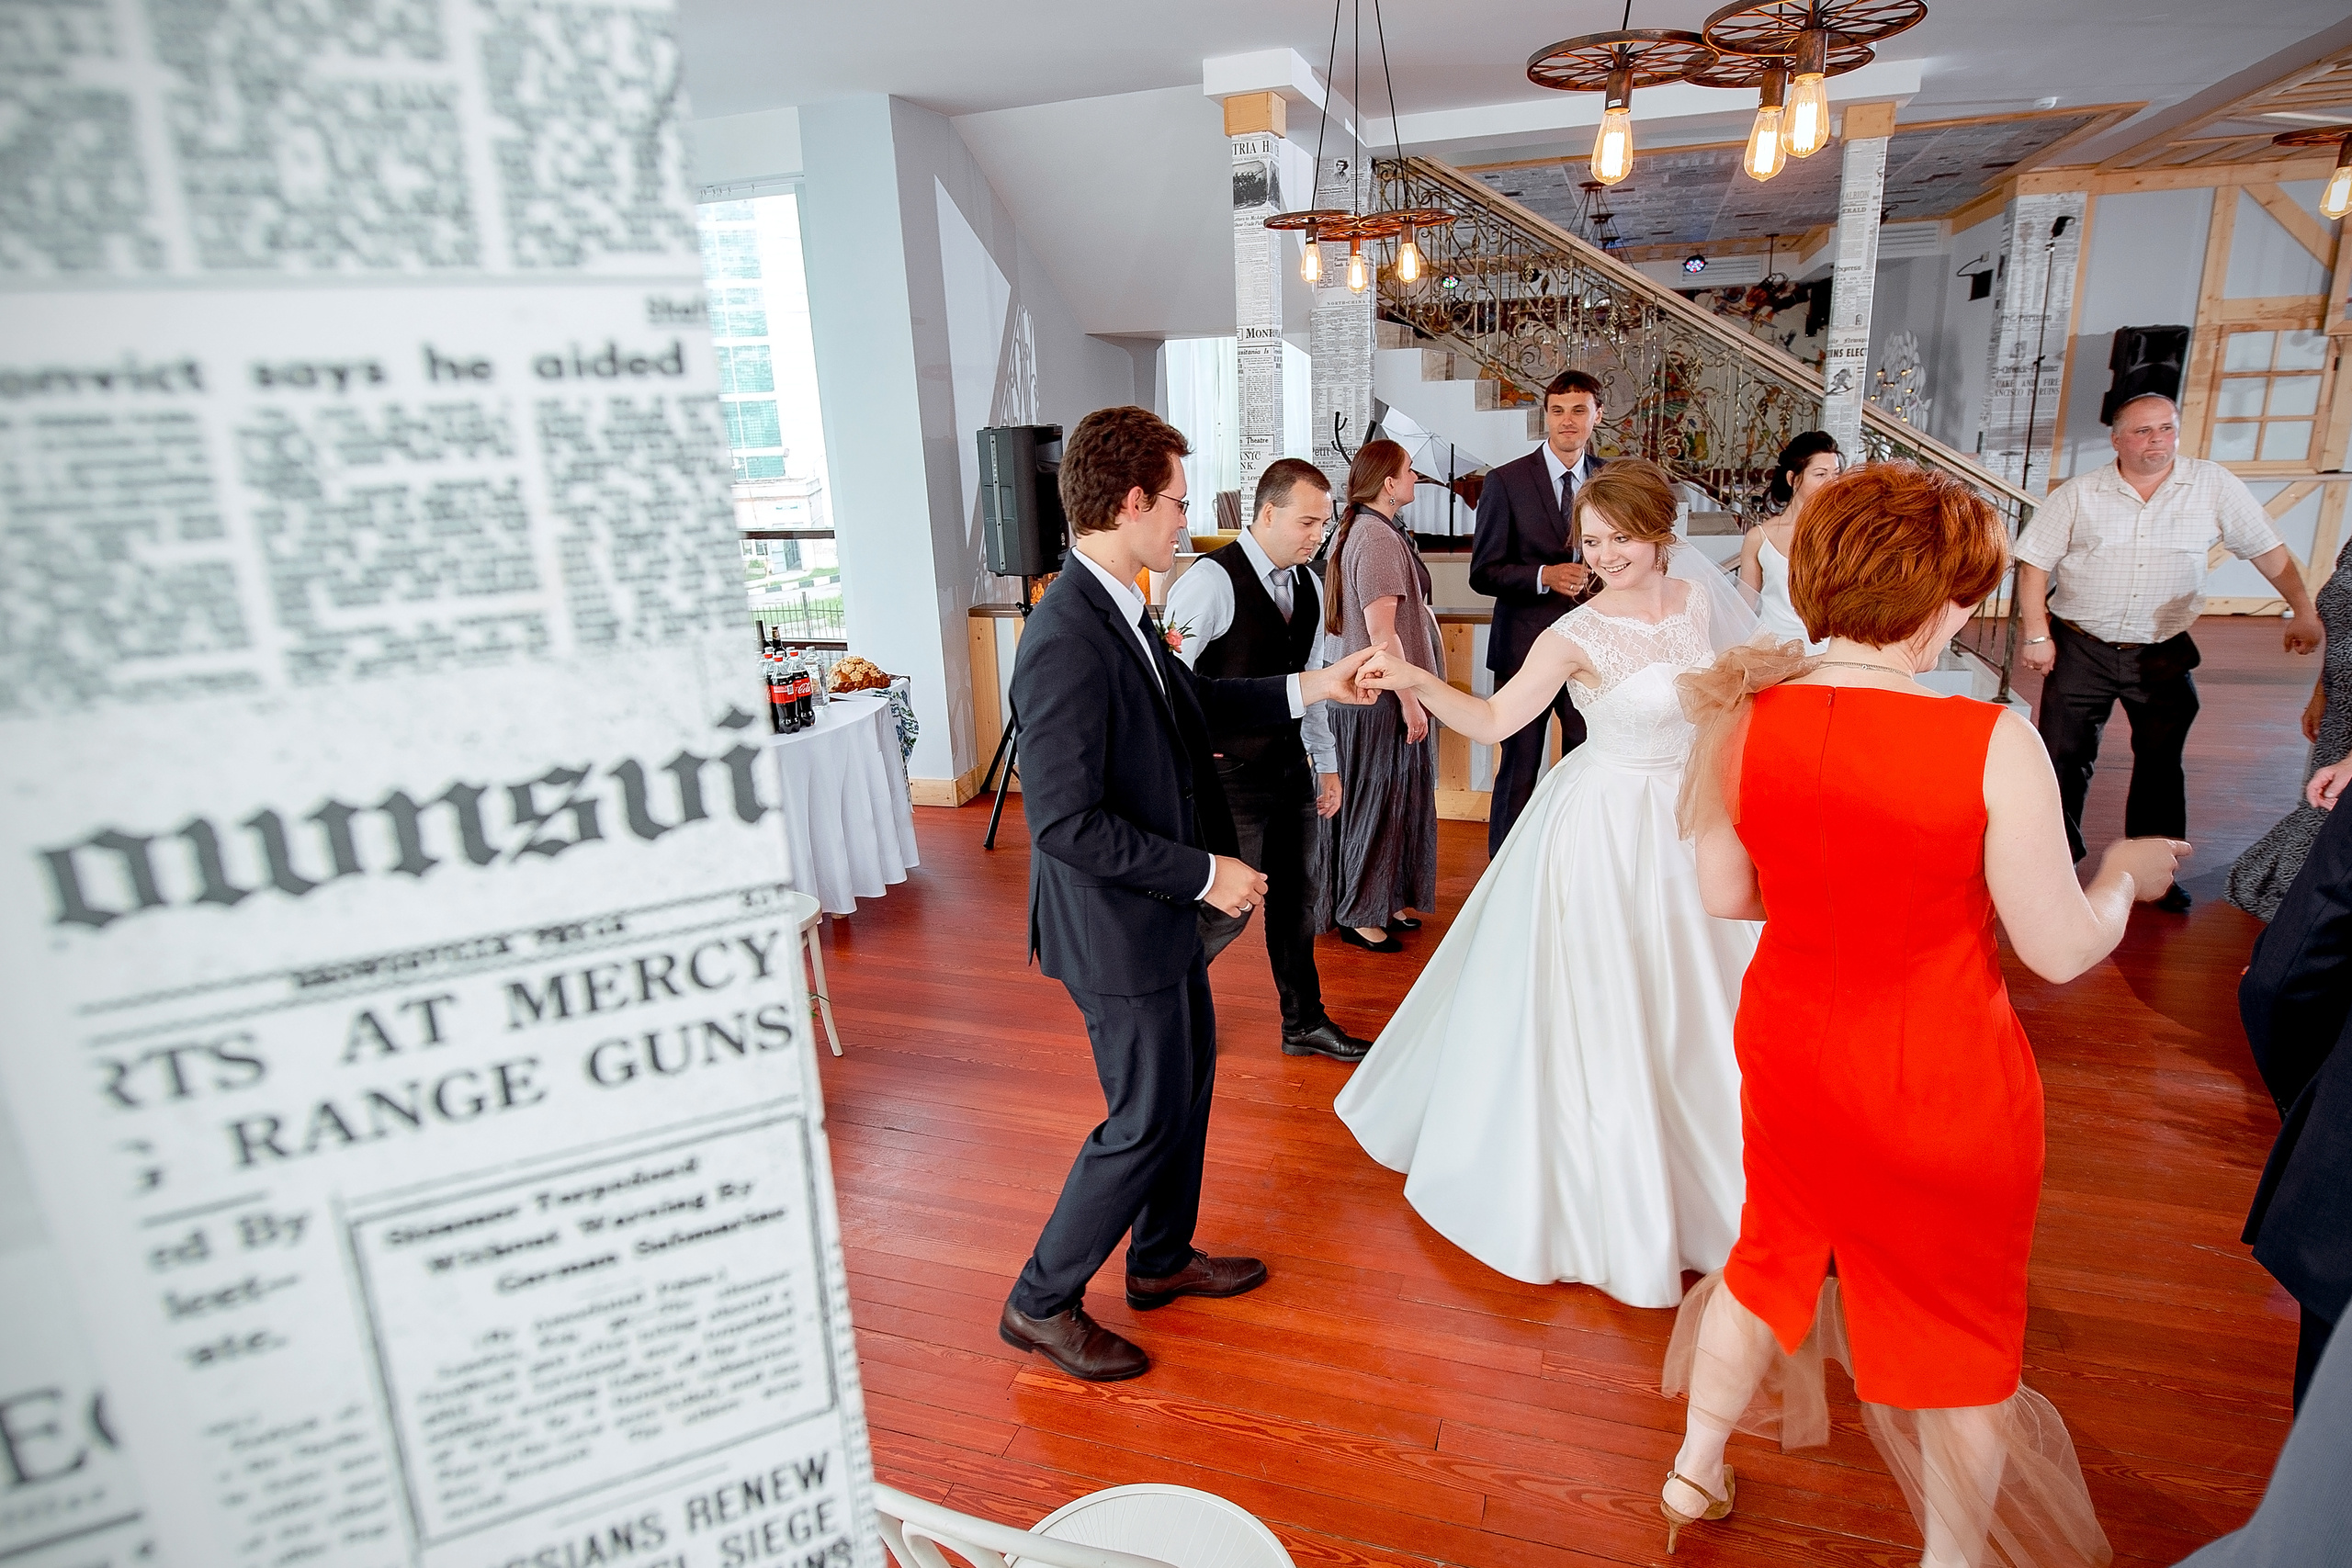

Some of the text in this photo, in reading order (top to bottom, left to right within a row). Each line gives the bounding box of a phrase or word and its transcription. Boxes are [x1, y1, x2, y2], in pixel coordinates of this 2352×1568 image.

[423, 340, 493, 382] he
[531, 337, 685, 379] aided
[341, 993, 458, 1064] AT
[503, 931, 781, 1032] MERCY
[229, 1056, 548, 1167] RANGE
[587, 1005, 795, 1089] GUNS
[685, 1450, 830, 1533] RENEW
[720, 1496, 837, 1567] SIEGE
